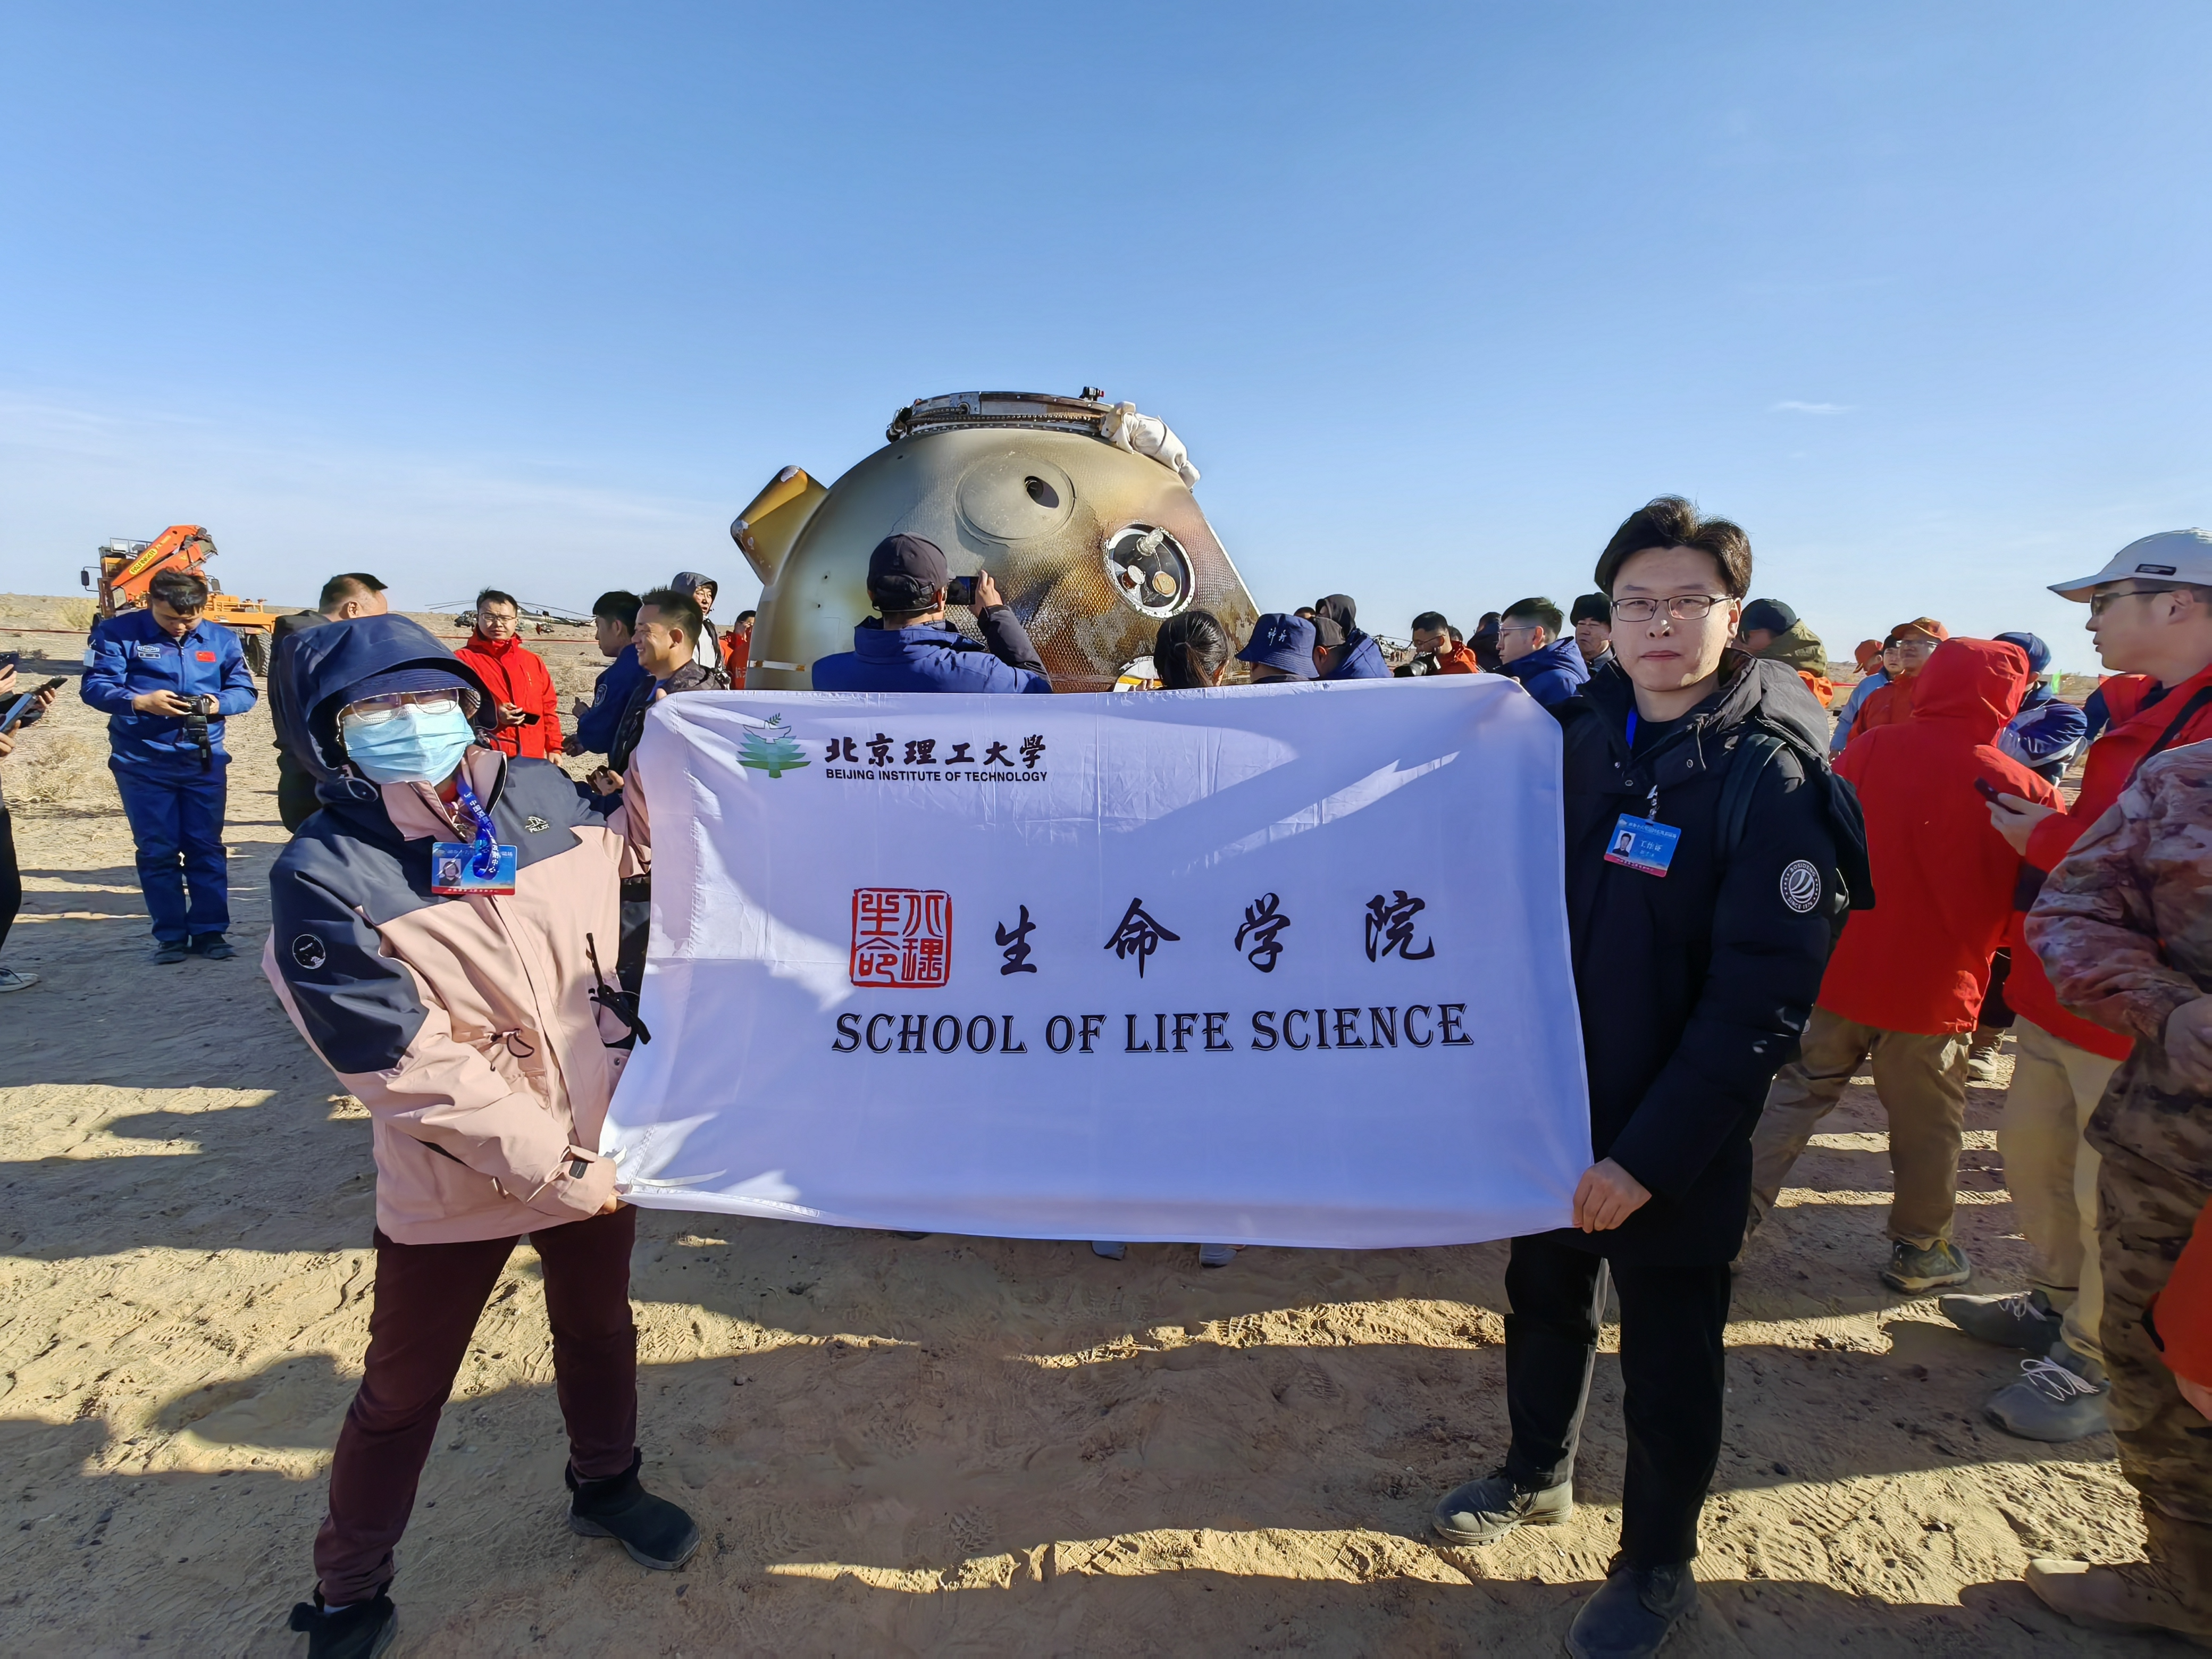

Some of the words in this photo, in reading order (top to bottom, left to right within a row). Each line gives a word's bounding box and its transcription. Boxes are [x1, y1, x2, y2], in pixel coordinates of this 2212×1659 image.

[826, 768, 875, 780] BEIJING
[878, 769, 941, 782] INSTITUTE
[945, 771, 961, 782] OF
[965, 771, 1048, 782] TECHNOLOGY
[1790, 863, 1816, 877] BOSIDENG
[832, 1012, 1028, 1054] SCHOOL
[1045, 1013, 1107, 1054] OF
[1124, 1011, 1234, 1053] LIFE
[1251, 1003, 1474, 1052] SCIENCE
